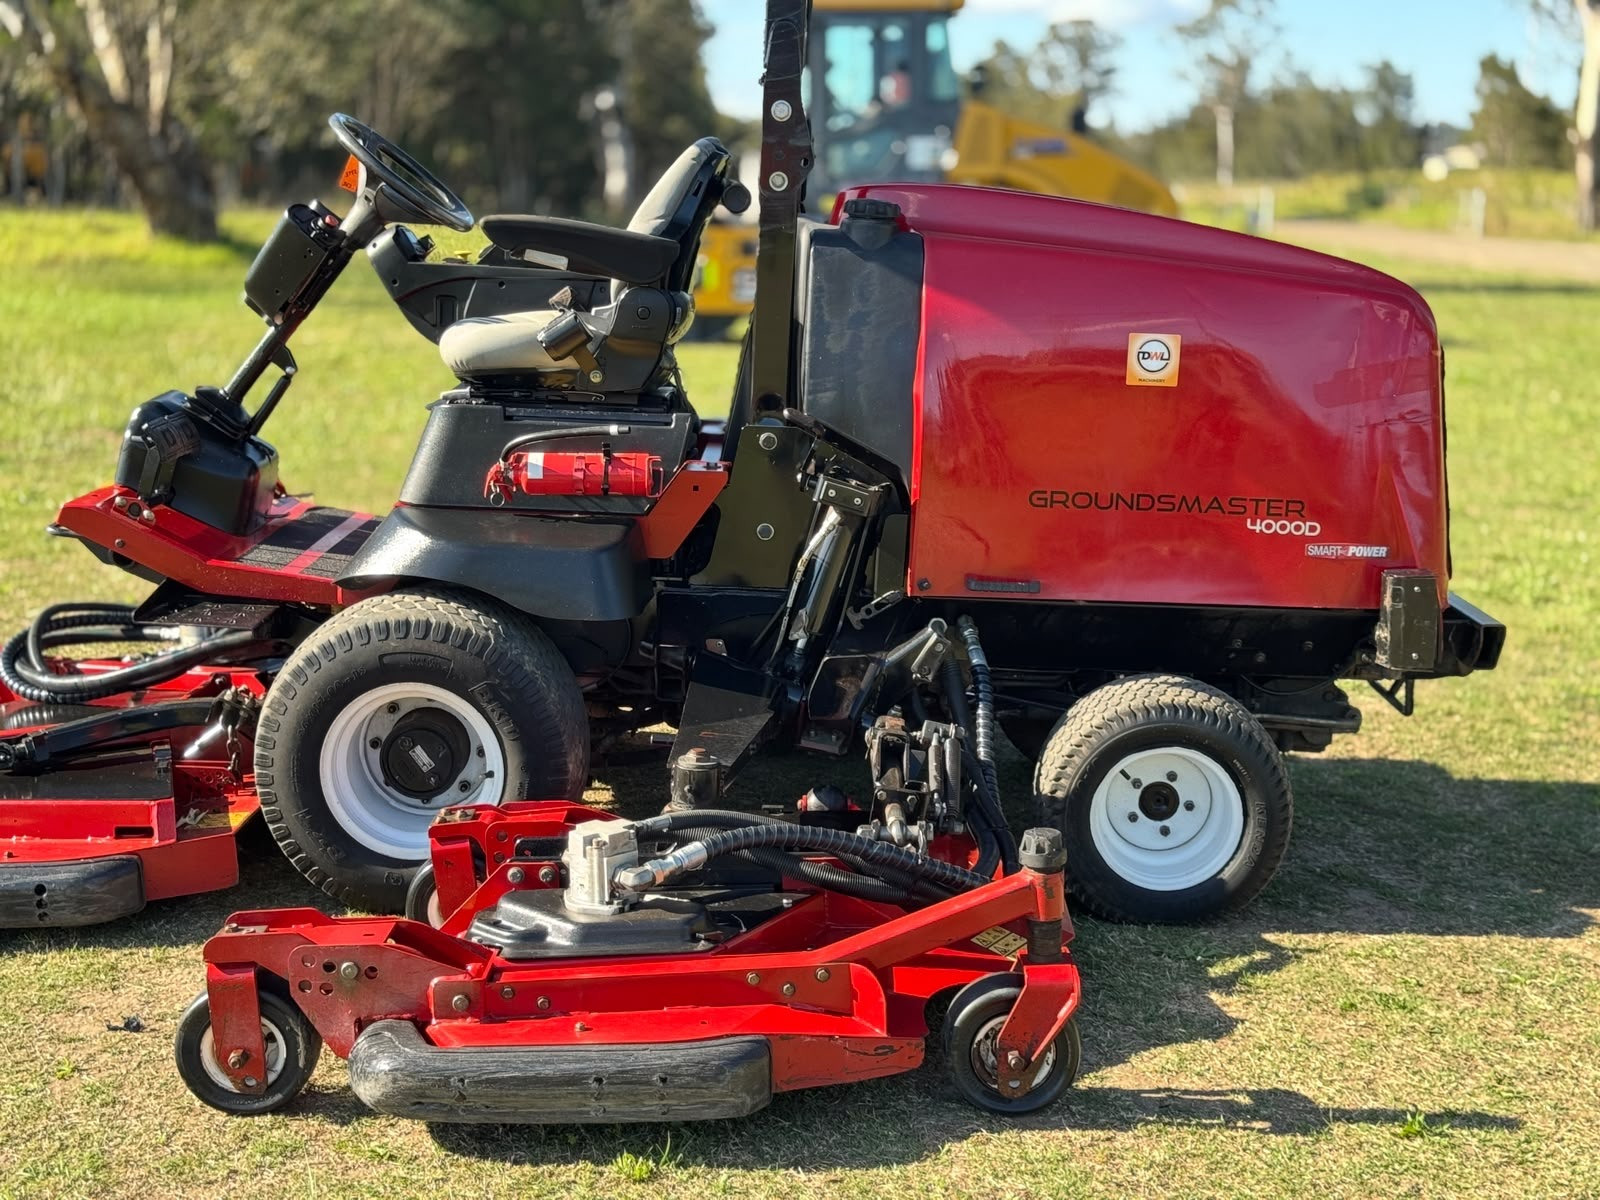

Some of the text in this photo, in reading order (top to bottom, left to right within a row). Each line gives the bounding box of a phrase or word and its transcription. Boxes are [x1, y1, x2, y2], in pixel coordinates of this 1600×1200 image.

[1138, 351, 1170, 361] DWL
[1028, 490, 1306, 518] GROUNDSMASTER
[1246, 518, 1322, 537] 4000D
[1307, 545, 1387, 557] SMART POWER
[1244, 801, 1267, 868] KENDA
